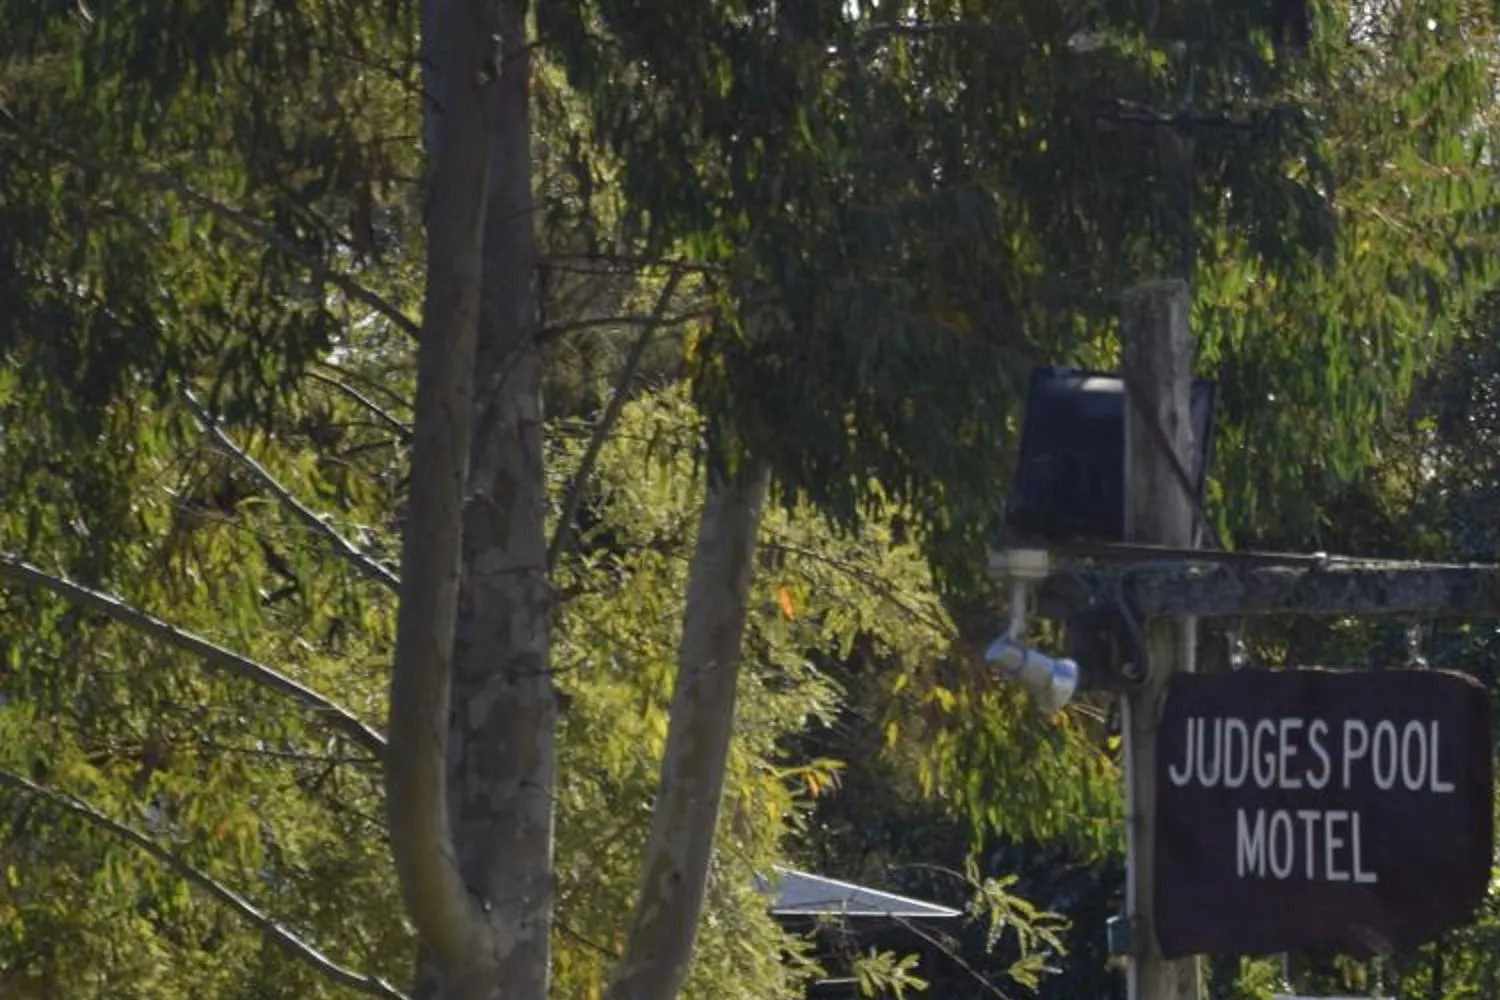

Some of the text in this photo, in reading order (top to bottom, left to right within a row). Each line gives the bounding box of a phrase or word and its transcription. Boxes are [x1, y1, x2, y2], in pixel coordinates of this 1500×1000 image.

[1168, 716, 1456, 793] JUDGES POOL
[1236, 808, 1378, 883] MOTEL
